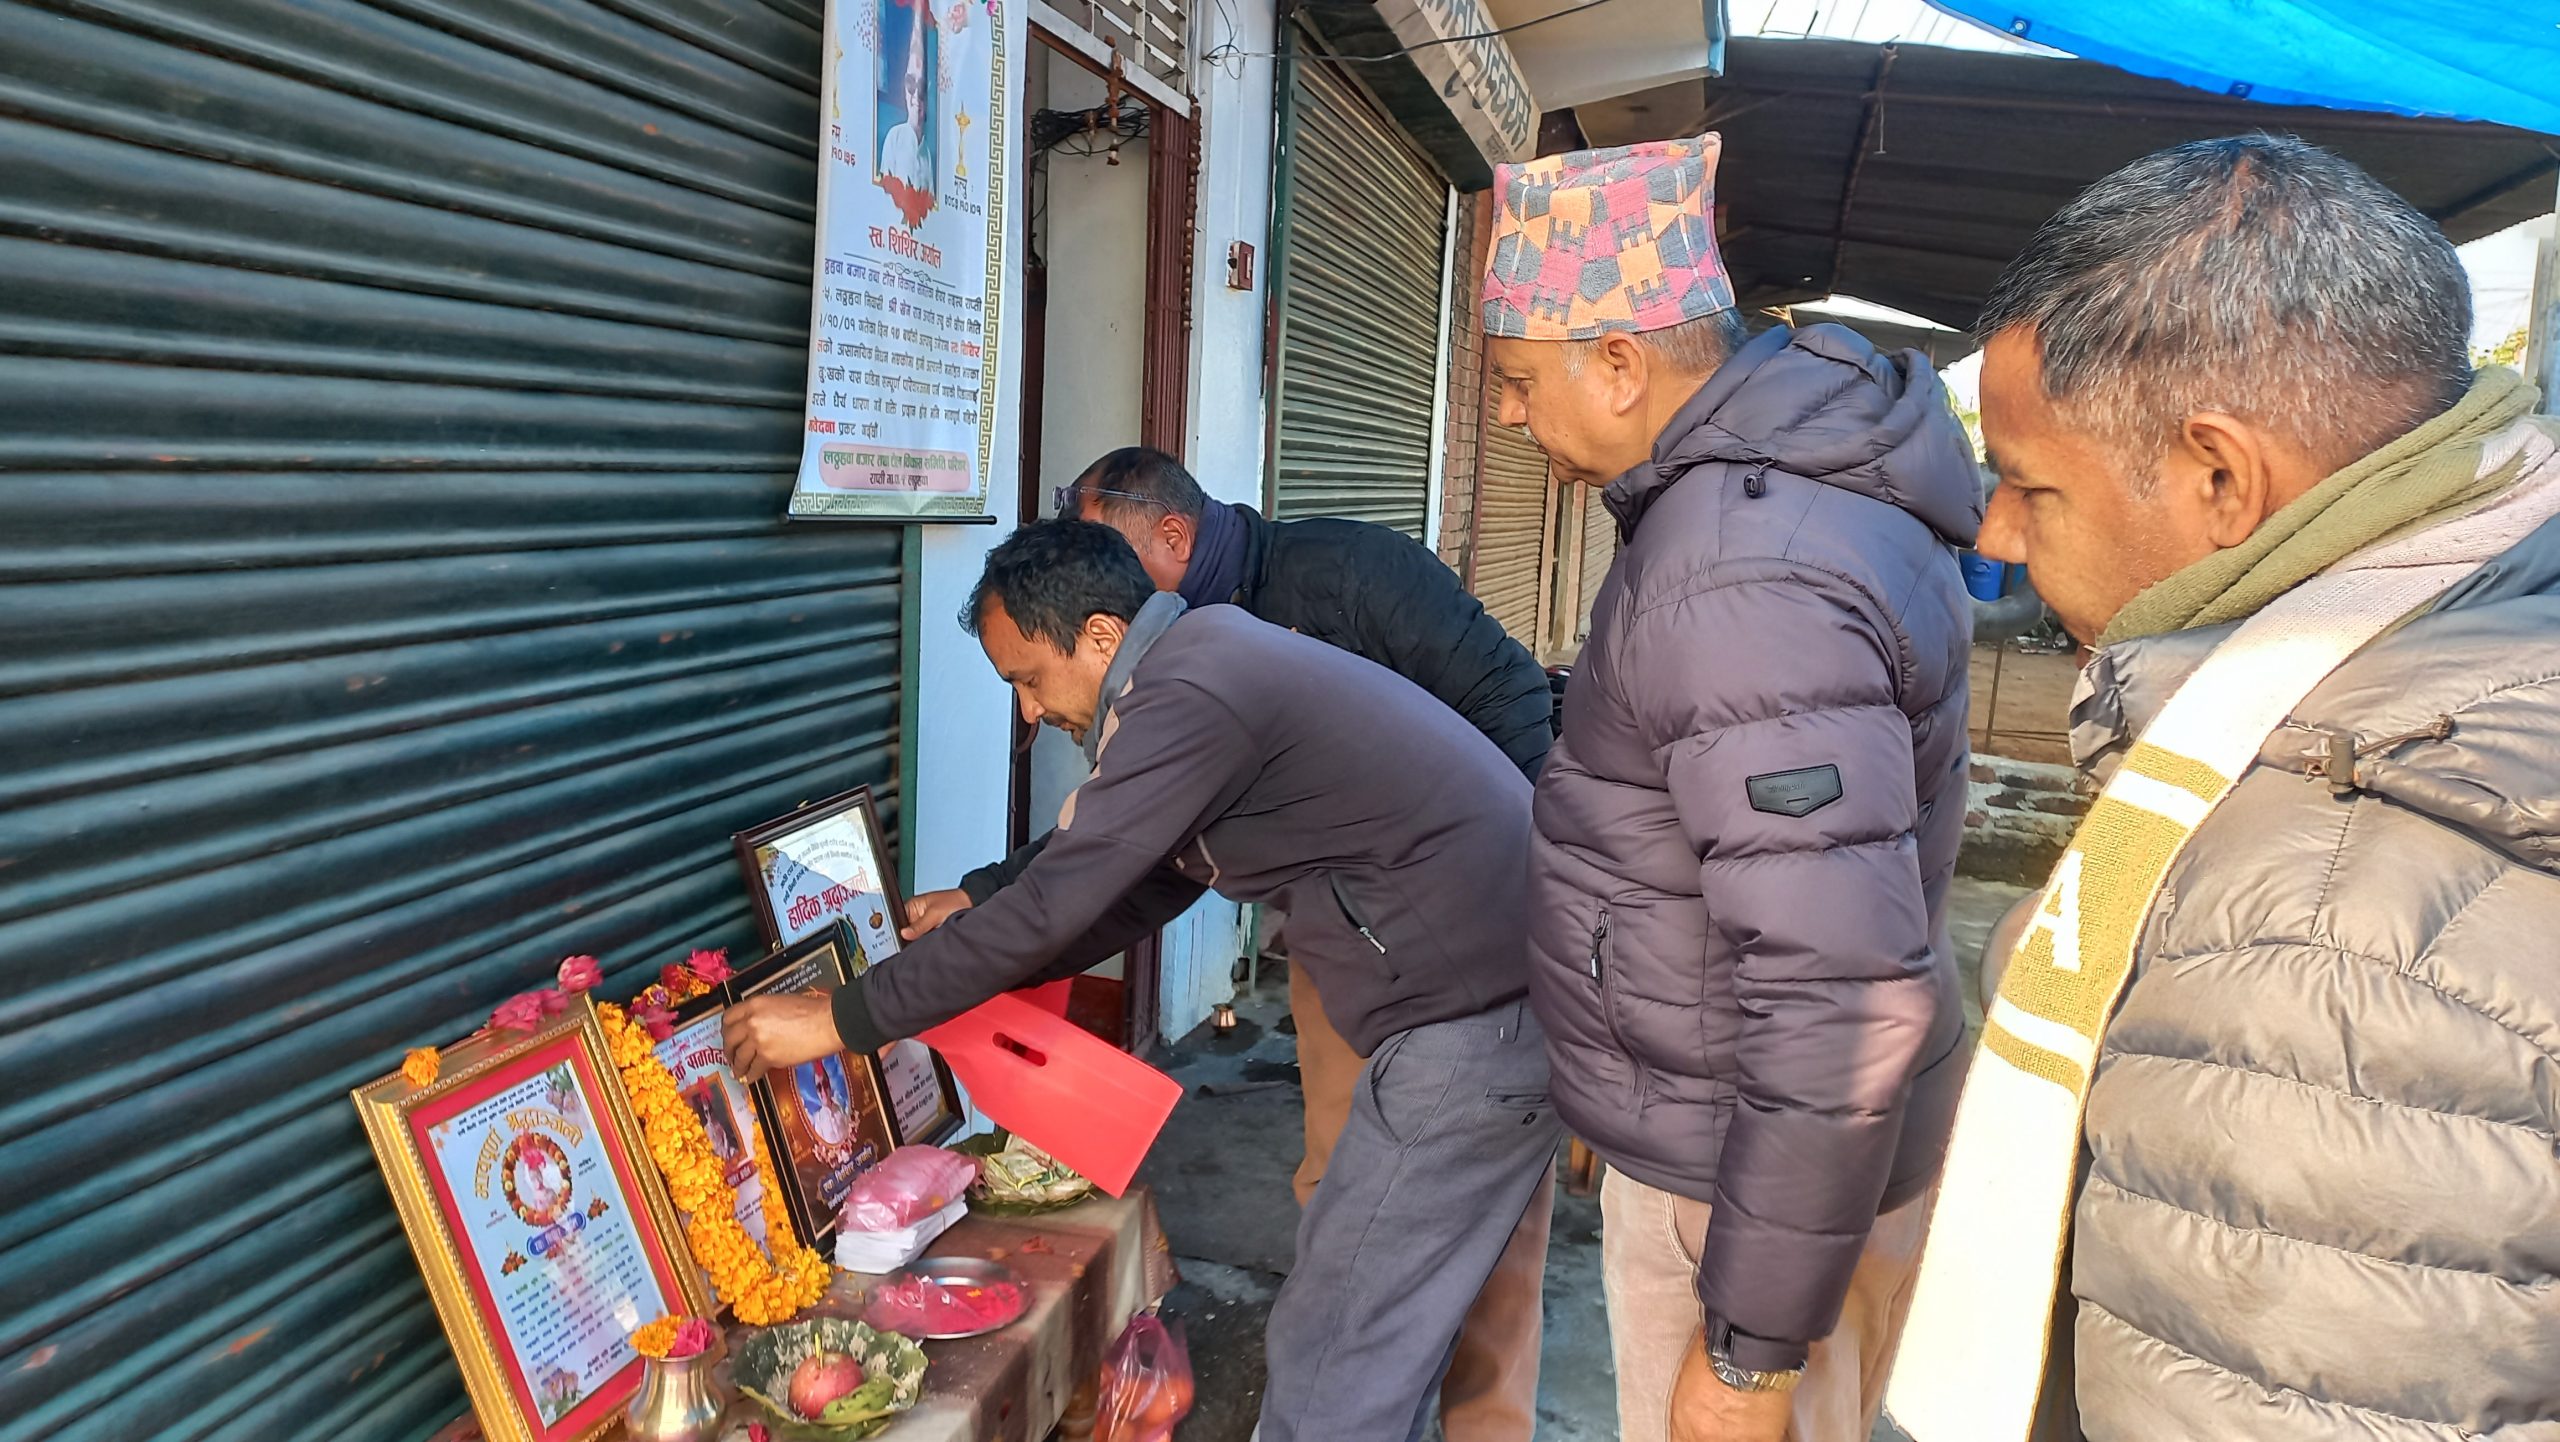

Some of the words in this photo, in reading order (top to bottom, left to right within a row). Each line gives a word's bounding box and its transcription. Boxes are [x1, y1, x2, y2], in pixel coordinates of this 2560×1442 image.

[889, 225, 919, 260] शिशिर
[920, 243, 942, 269] अर्याल
[847, 263, 866, 280] बजार
[882, 270, 896, 288] टोल
[964, 296, 982, 312] राप्ती
[849, 370, 862, 384] यस
[838, 422, 857, 436] प्रकट
[856, 452, 875, 467] बजार
[903, 452, 923, 468] विकास
[869, 471, 885, 486] राप्ती
[786, 894, 822, 931] हार्दिक
[2014, 849, 2085, 973] A
